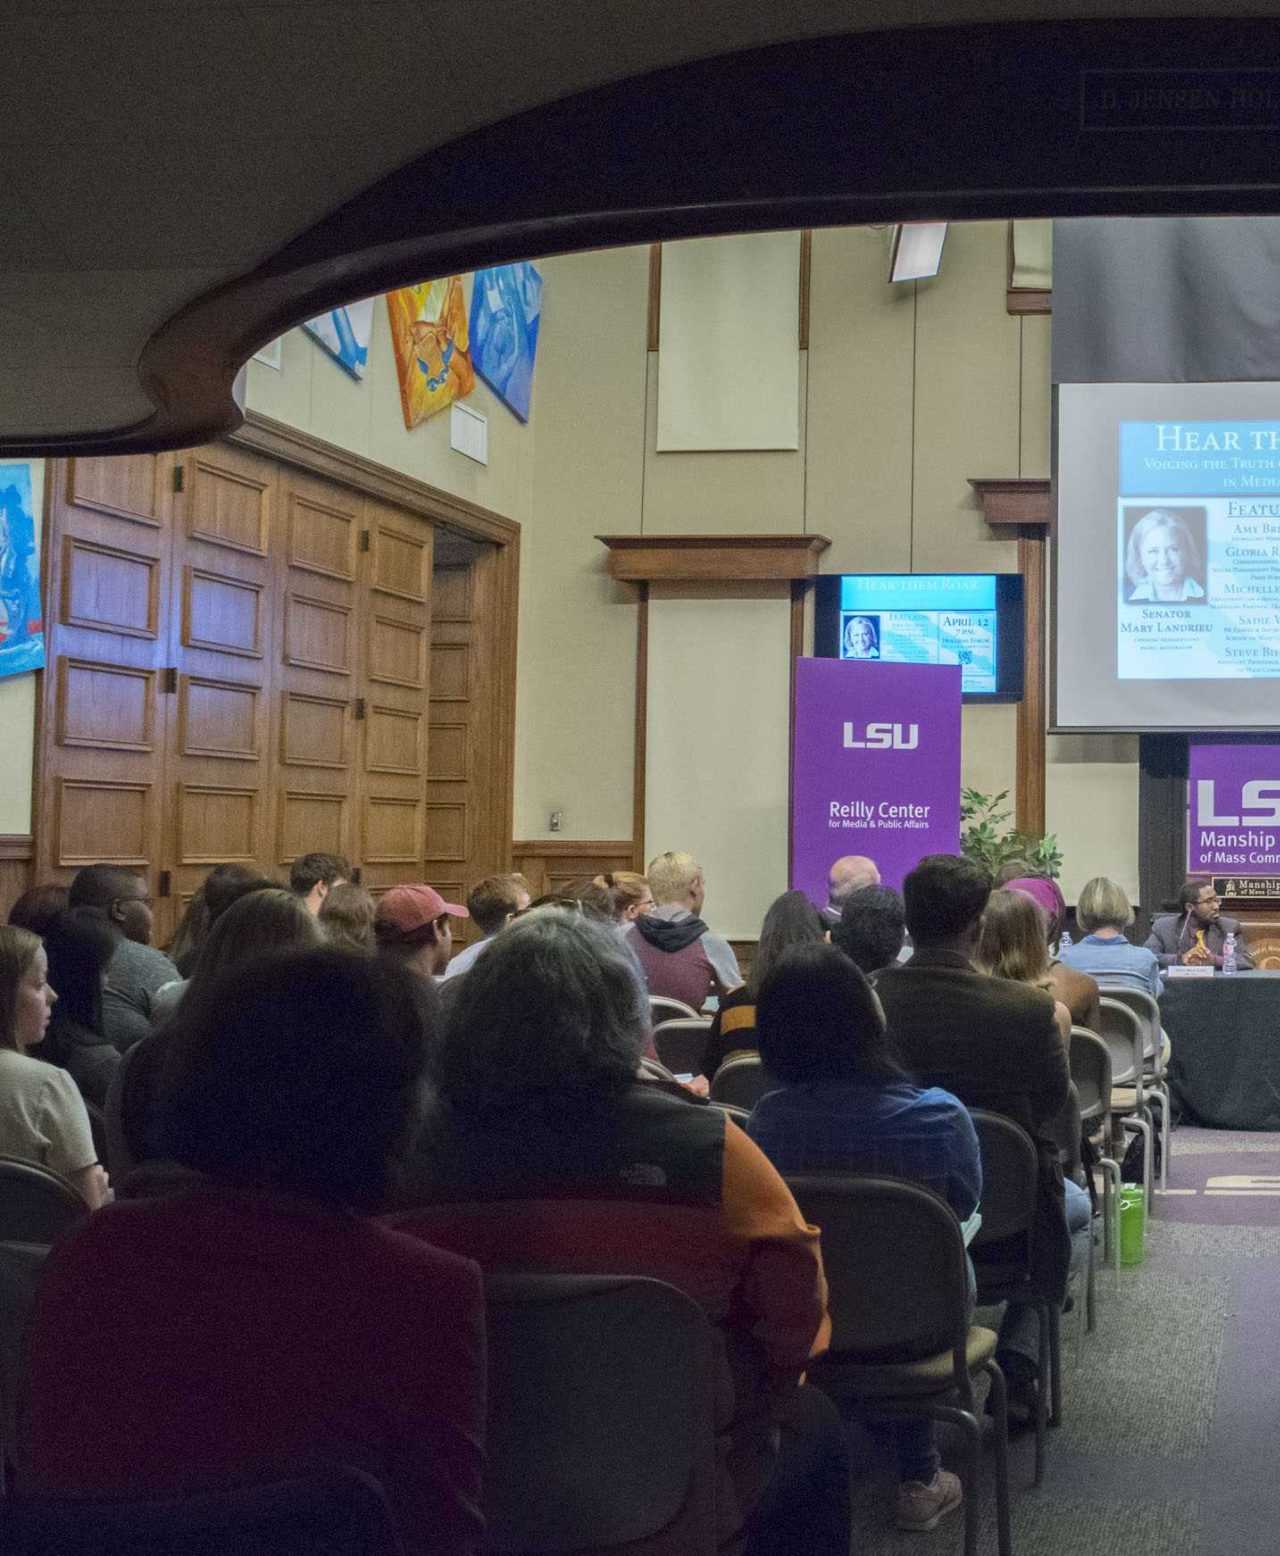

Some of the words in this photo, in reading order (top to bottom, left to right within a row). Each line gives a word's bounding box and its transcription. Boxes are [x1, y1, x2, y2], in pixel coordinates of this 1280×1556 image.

[1156, 424, 1241, 451] HEAR
[1143, 457, 1198, 470] VOICING
[1203, 458, 1228, 470] THE
[1231, 456, 1274, 469] TRUTH
[1233, 523, 1259, 534] AMY
[1225, 546, 1269, 557] GLORIA
[1142, 608, 1192, 619] SENATOR
[1120, 623, 1154, 633] MARY
[1157, 622, 1214, 633] LANDRIEU
[843, 721, 919, 750] LSU
[829, 801, 874, 820] Reilly
[878, 802, 931, 818] Center
[829, 819, 841, 829] for
[842, 819, 868, 829] Media
[869, 820, 876, 829] &
[878, 819, 902, 829] Public
[904, 819, 930, 830] Affairs
[1200, 832, 1276, 851] Manship
[1200, 852, 1214, 864] of
[1215, 853, 1247, 864] Mass
